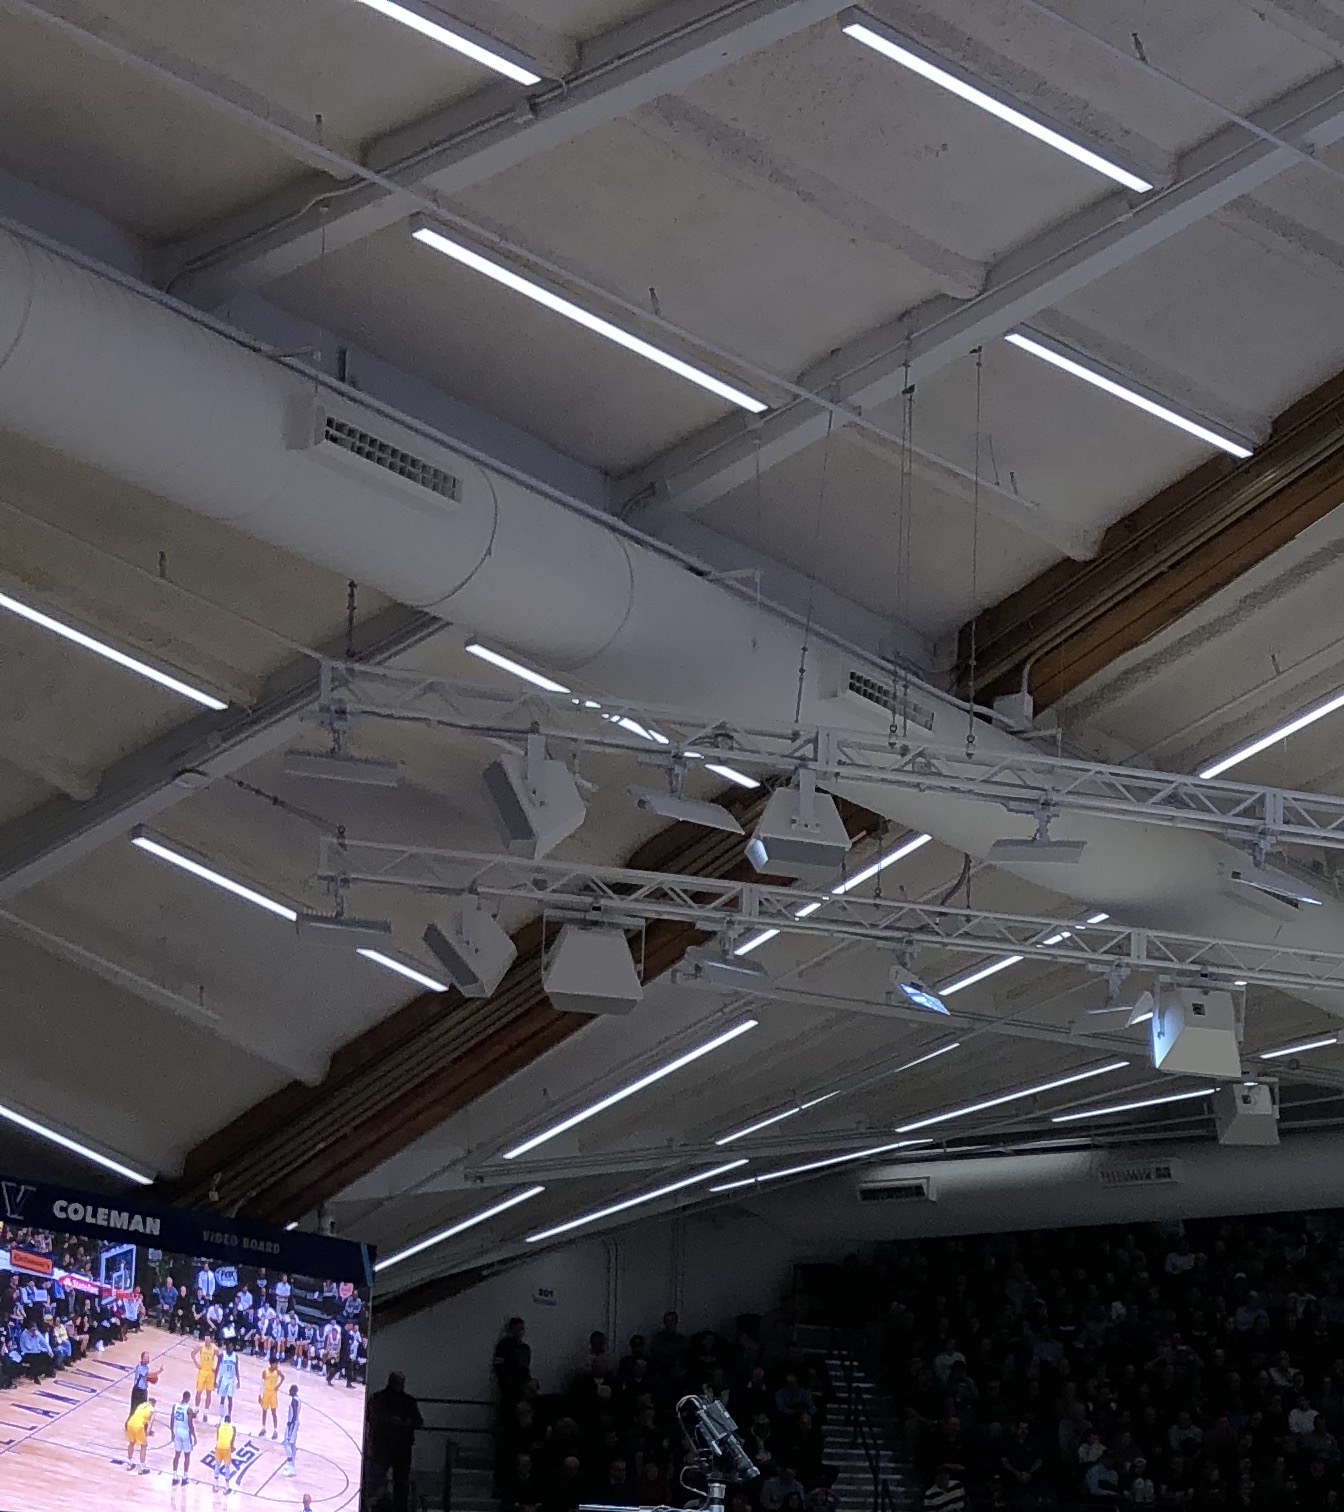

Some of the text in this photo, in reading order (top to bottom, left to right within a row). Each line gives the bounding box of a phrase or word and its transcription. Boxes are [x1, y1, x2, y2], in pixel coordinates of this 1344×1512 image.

[51, 1198, 161, 1237] COLEMAN
[201, 1228, 240, 1248] VIDEO
[242, 1236, 282, 1256] BOARD
